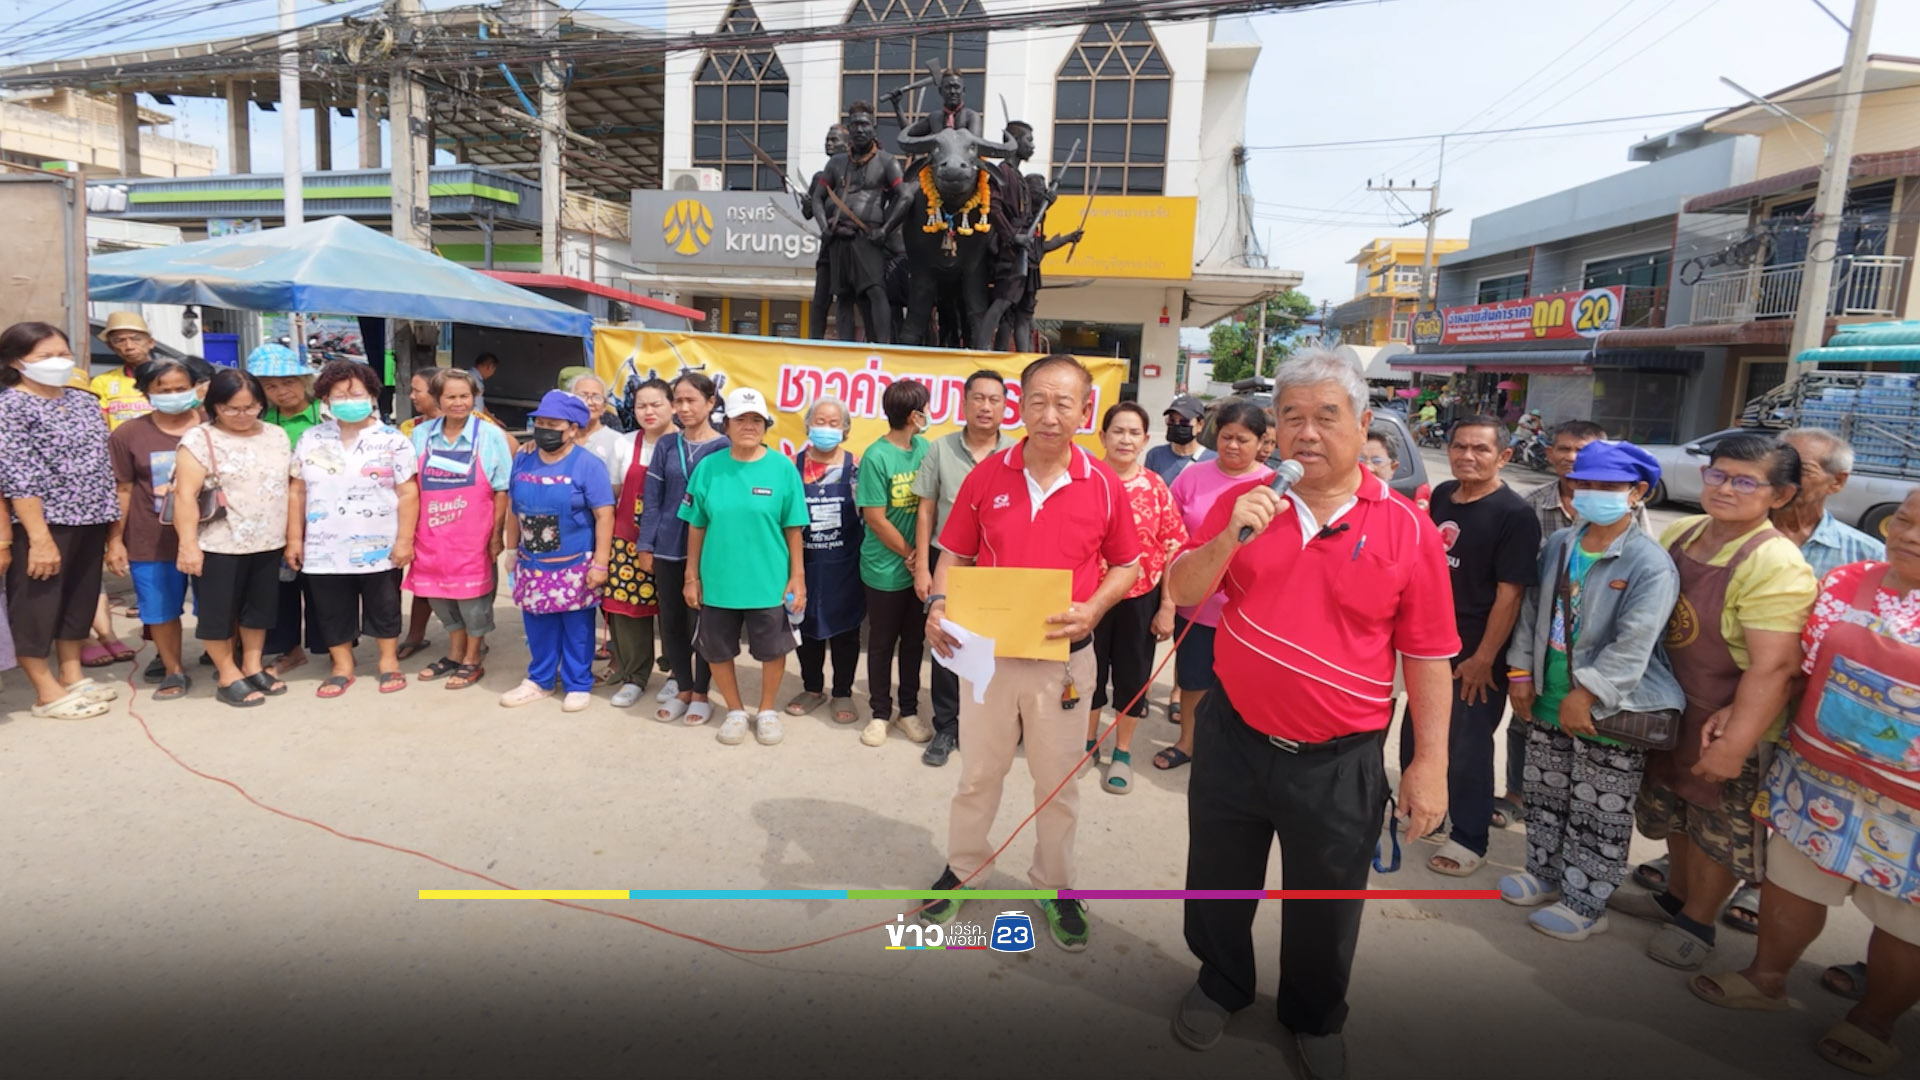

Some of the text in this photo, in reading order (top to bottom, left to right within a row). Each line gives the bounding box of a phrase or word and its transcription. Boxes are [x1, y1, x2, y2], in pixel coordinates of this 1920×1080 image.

[727, 202, 776, 225] กรุงศรี
[1532, 298, 1566, 338] ถูก
[1576, 294, 1611, 332] 20
